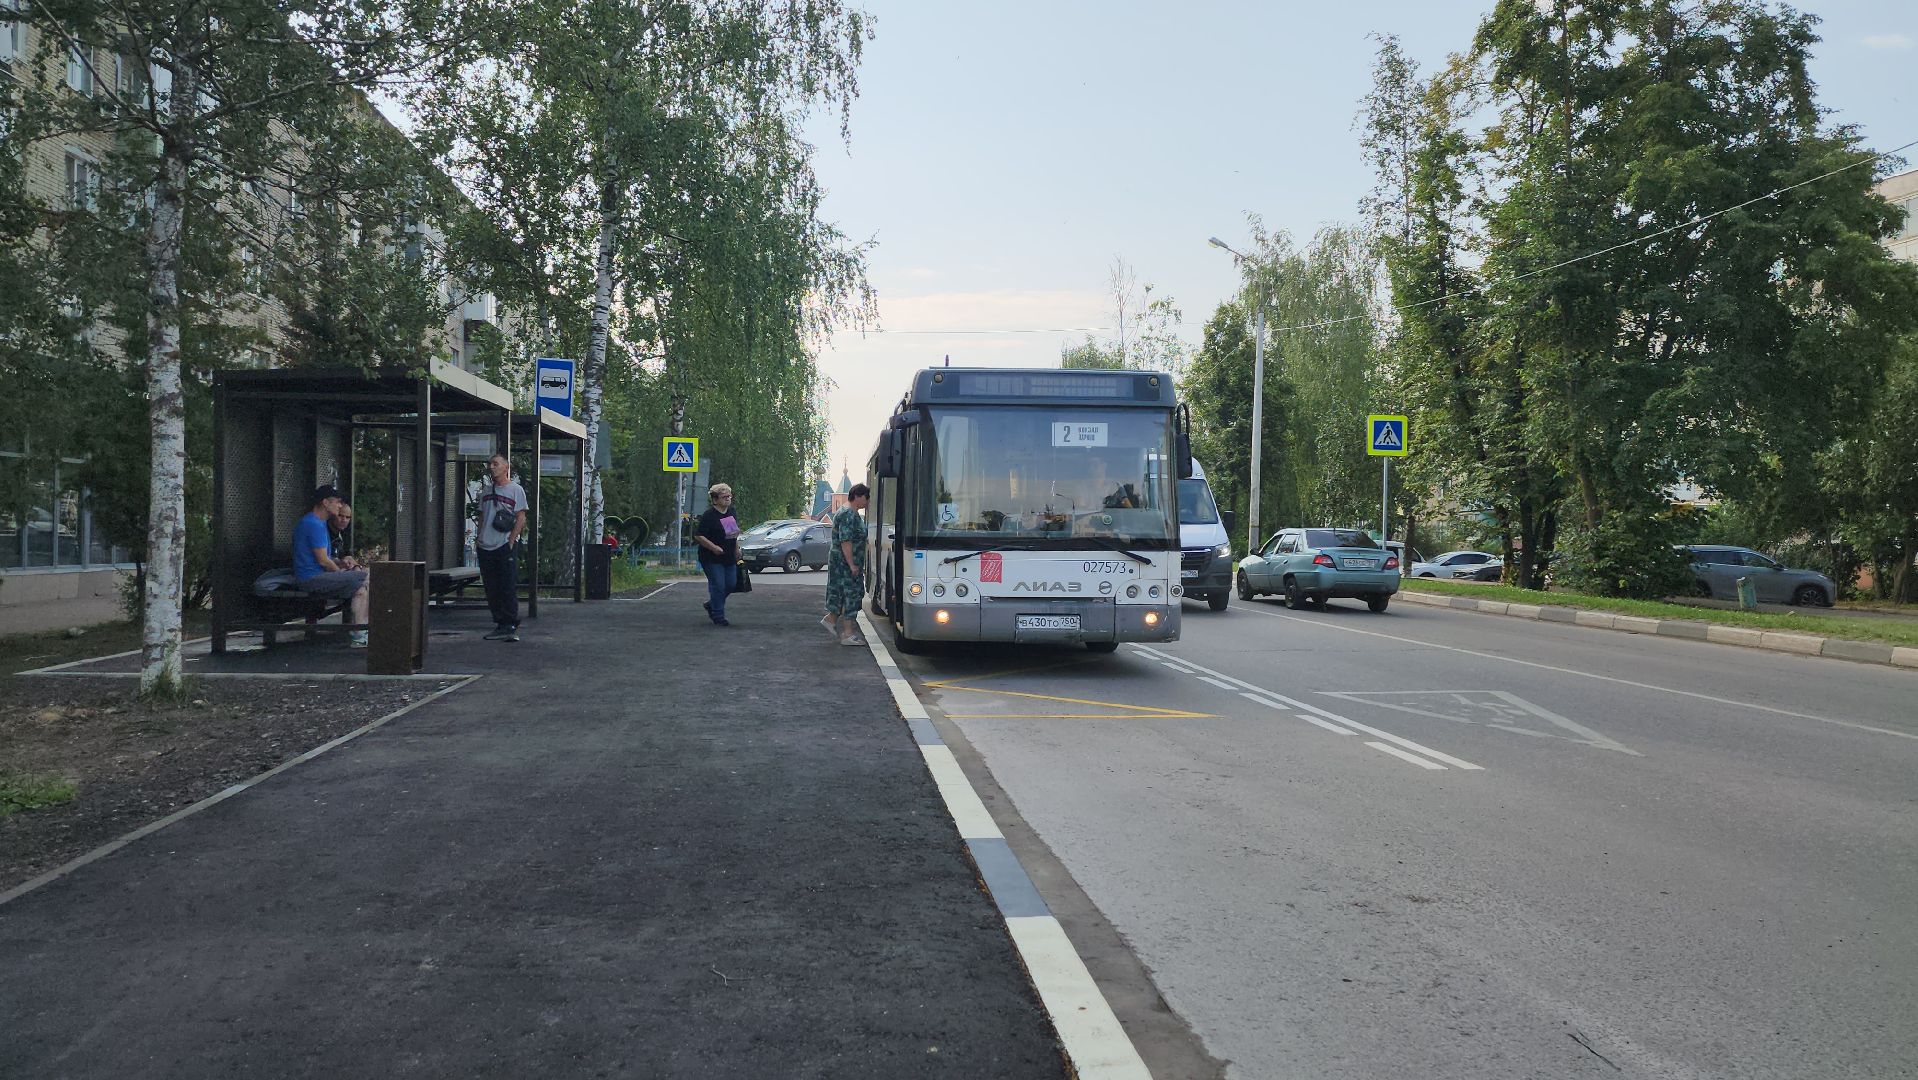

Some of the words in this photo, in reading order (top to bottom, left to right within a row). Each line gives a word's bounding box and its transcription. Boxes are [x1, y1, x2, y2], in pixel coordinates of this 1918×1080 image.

[1063, 425, 1071, 442] 2
[1083, 561, 1126, 574] 027573
[1013, 581, 1081, 592] ЛИАЗ
[1021, 617, 1059, 627] В430ТО
